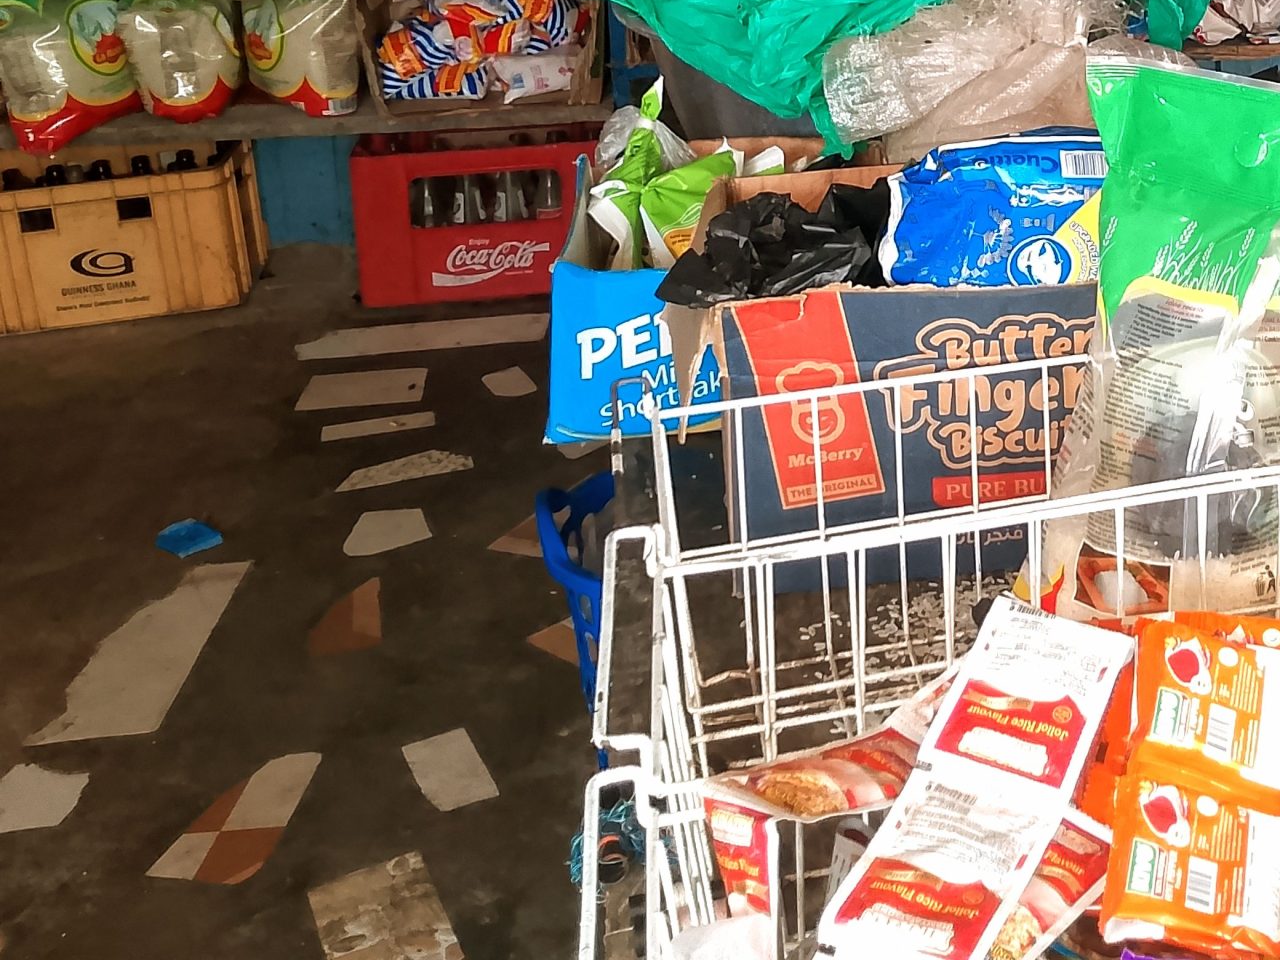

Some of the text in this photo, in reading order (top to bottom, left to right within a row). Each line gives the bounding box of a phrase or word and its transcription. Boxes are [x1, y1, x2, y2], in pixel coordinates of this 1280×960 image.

[446, 241, 535, 272] Coca-Cola
[61, 280, 137, 296] GUINNESS GHANA
[930, 323, 1092, 368] Butter
[788, 446, 864, 469] McBerry
[790, 485, 814, 499] THE
[945, 480, 1006, 502] PURE
[967, 705, 1070, 742] Flavour Rice Jollof
[869, 881, 916, 902] Flavour
[916, 895, 943, 912] Rice
